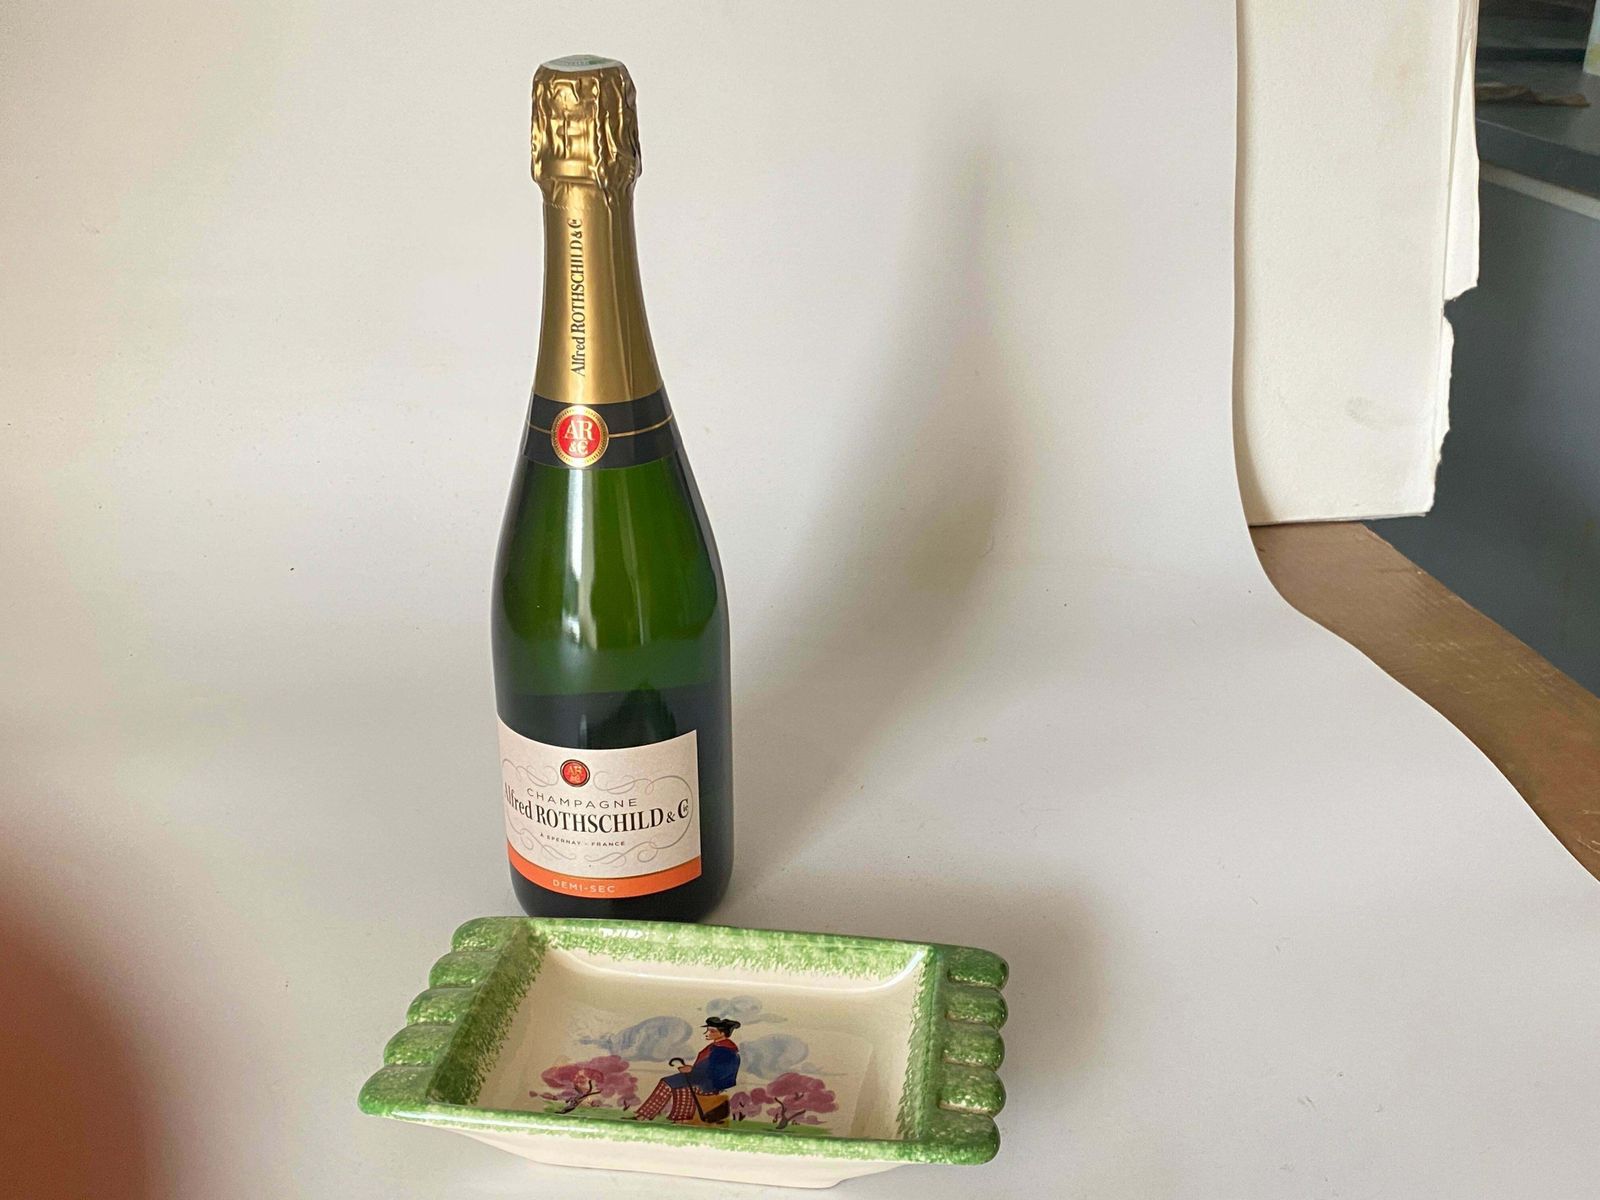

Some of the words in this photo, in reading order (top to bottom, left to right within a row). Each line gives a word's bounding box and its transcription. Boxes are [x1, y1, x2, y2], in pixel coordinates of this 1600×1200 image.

[570, 240, 586, 334] ROTHSCHILD
[571, 336, 585, 377] Alfred
[563, 419, 596, 440] AR
[526, 787, 638, 809] CHAMPAGNE
[535, 804, 664, 834] ROTHSCHILD
[666, 811, 676, 824] &
[591, 840, 626, 848] FRANCE
[552, 879, 616, 893] DEMI-SEC
